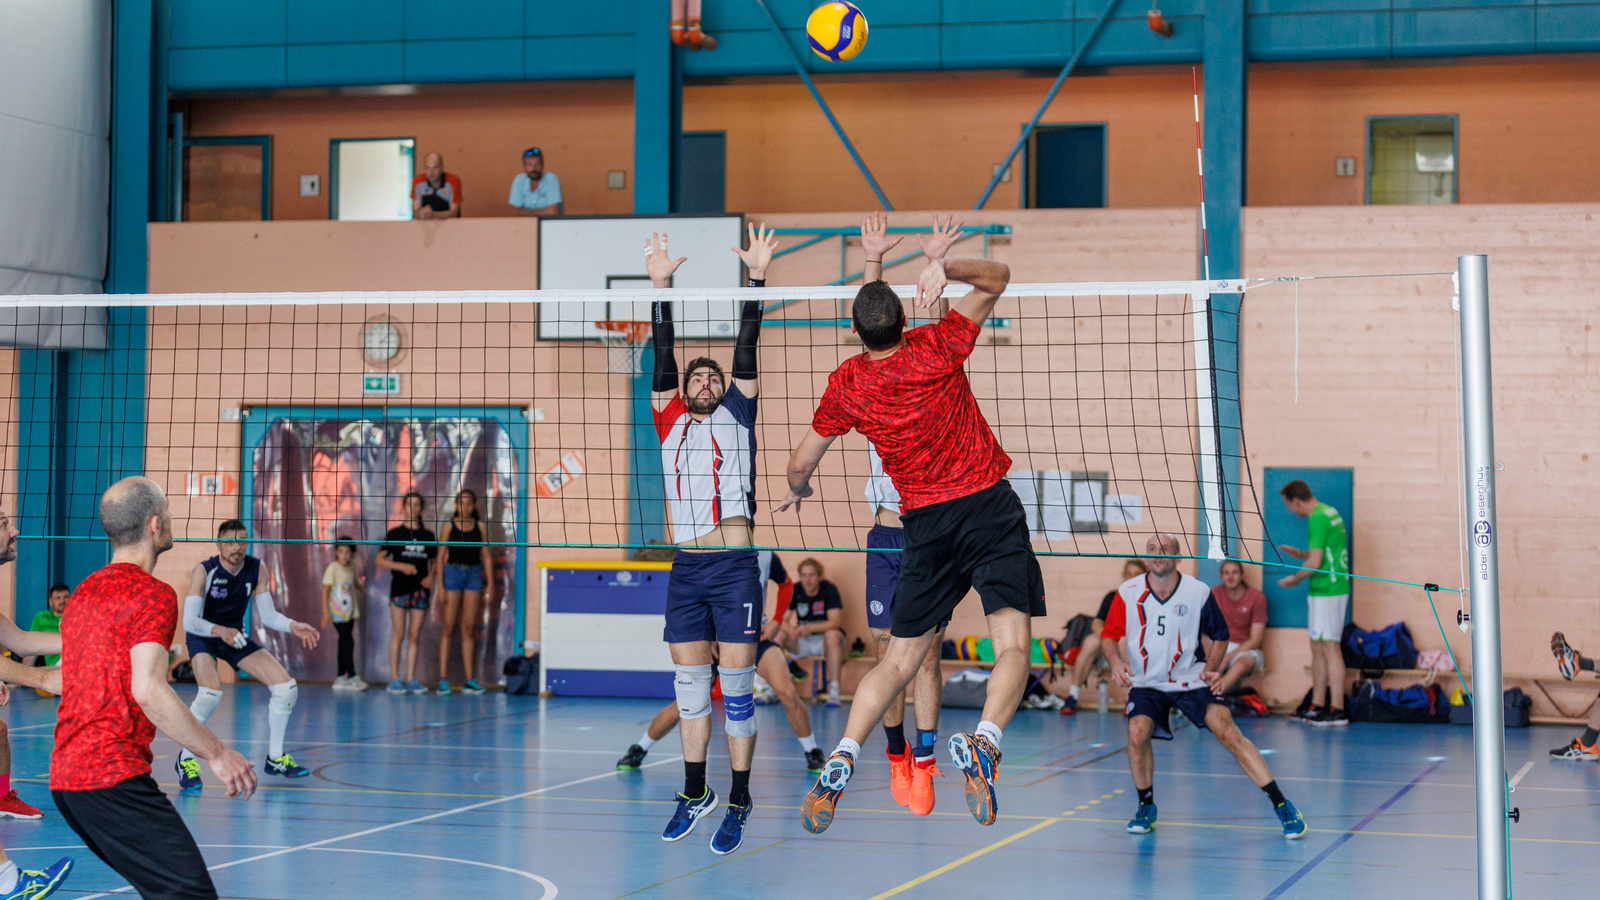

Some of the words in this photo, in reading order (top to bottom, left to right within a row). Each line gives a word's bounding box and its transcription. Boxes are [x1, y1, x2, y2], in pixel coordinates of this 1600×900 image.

[1476, 466, 1485, 517] eisenhut
[1480, 550, 1488, 580] alder
[743, 602, 753, 628] 7
[1157, 615, 1166, 636] 5
